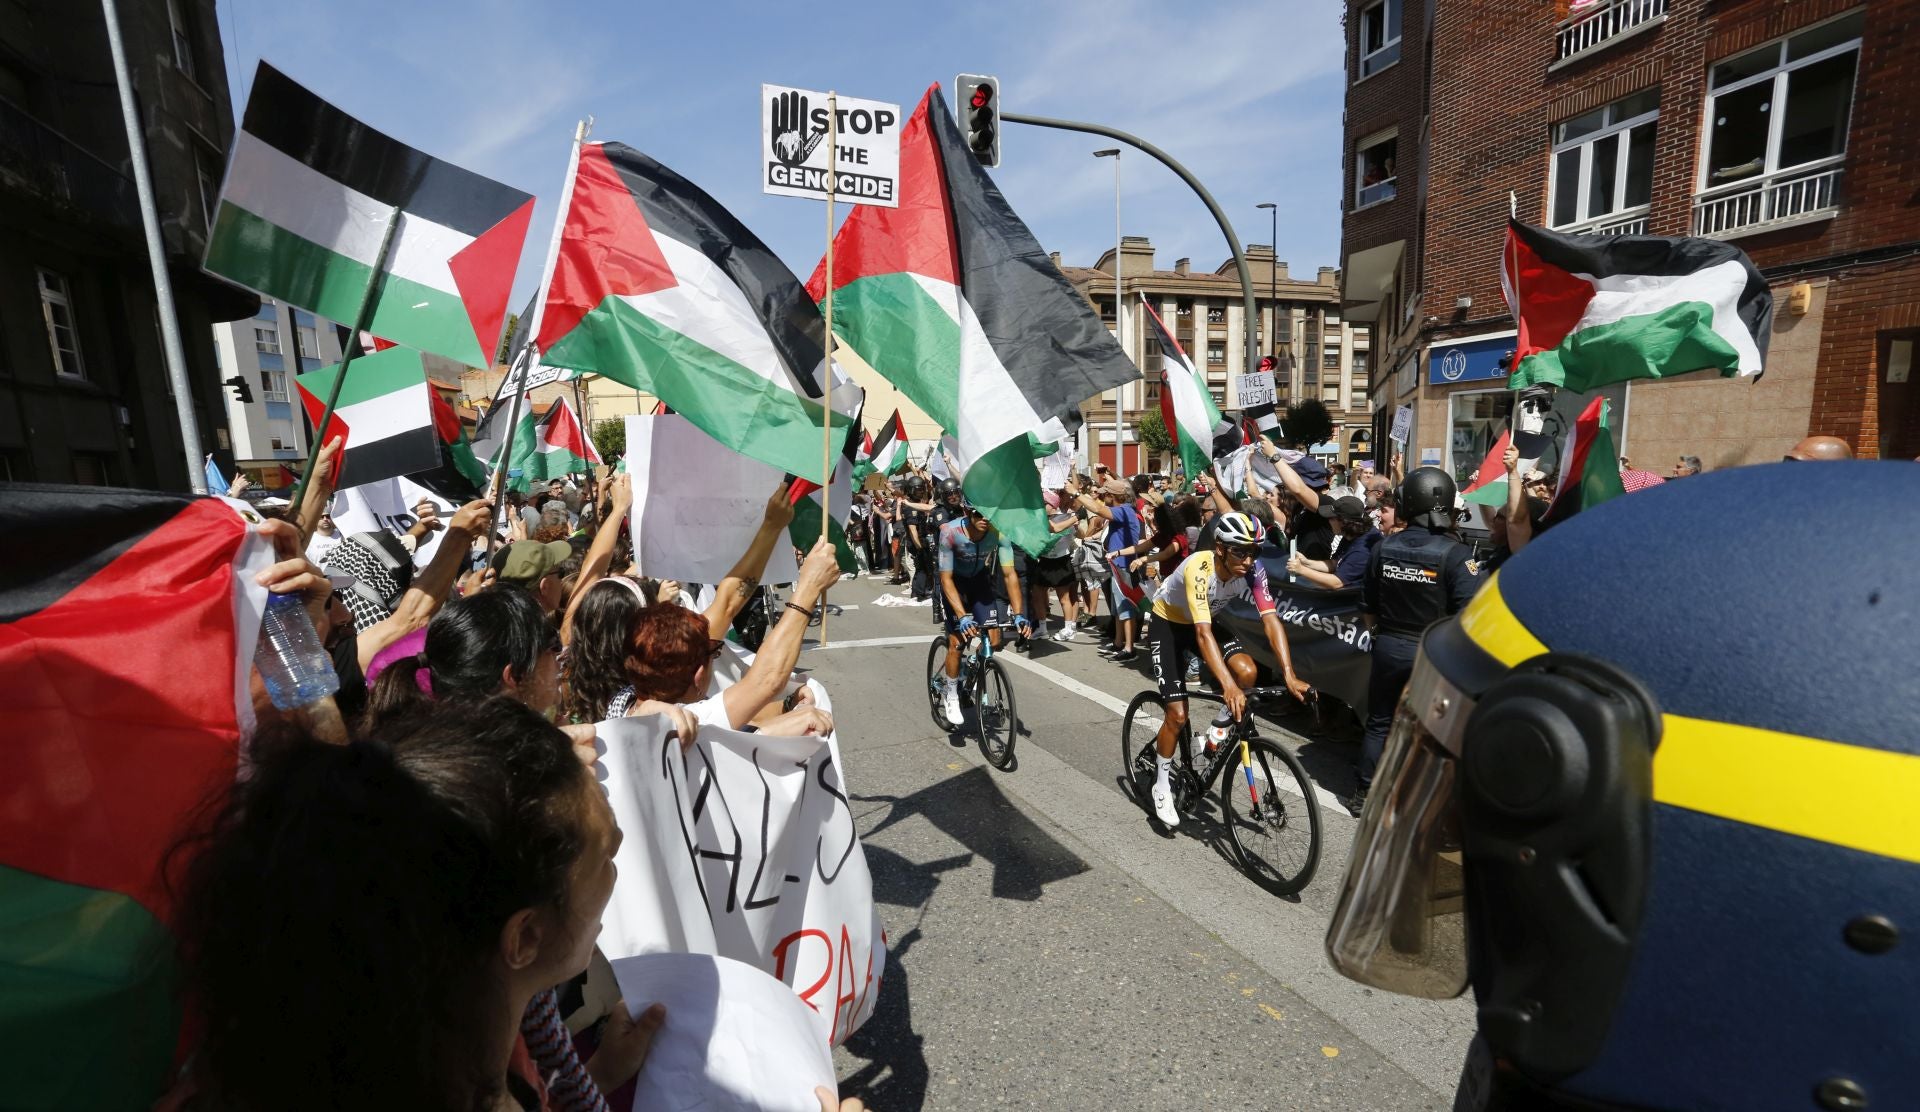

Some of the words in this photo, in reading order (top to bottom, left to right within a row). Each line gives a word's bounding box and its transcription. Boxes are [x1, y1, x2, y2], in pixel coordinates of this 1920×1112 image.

[810, 108, 895, 135] STOP
[770, 164, 892, 199] GENOCIDE
[504, 368, 558, 393] GEOCIDE
[1244, 374, 1265, 389] FREE
[1238, 388, 1275, 407] PALESTINE
[1382, 564, 1425, 577] POLICIA
[1382, 571, 1437, 585] NACIONAL
[1195, 576, 1207, 611] INEOS
[1255, 567, 1273, 602] INEOS
[1308, 613, 1360, 645] está
